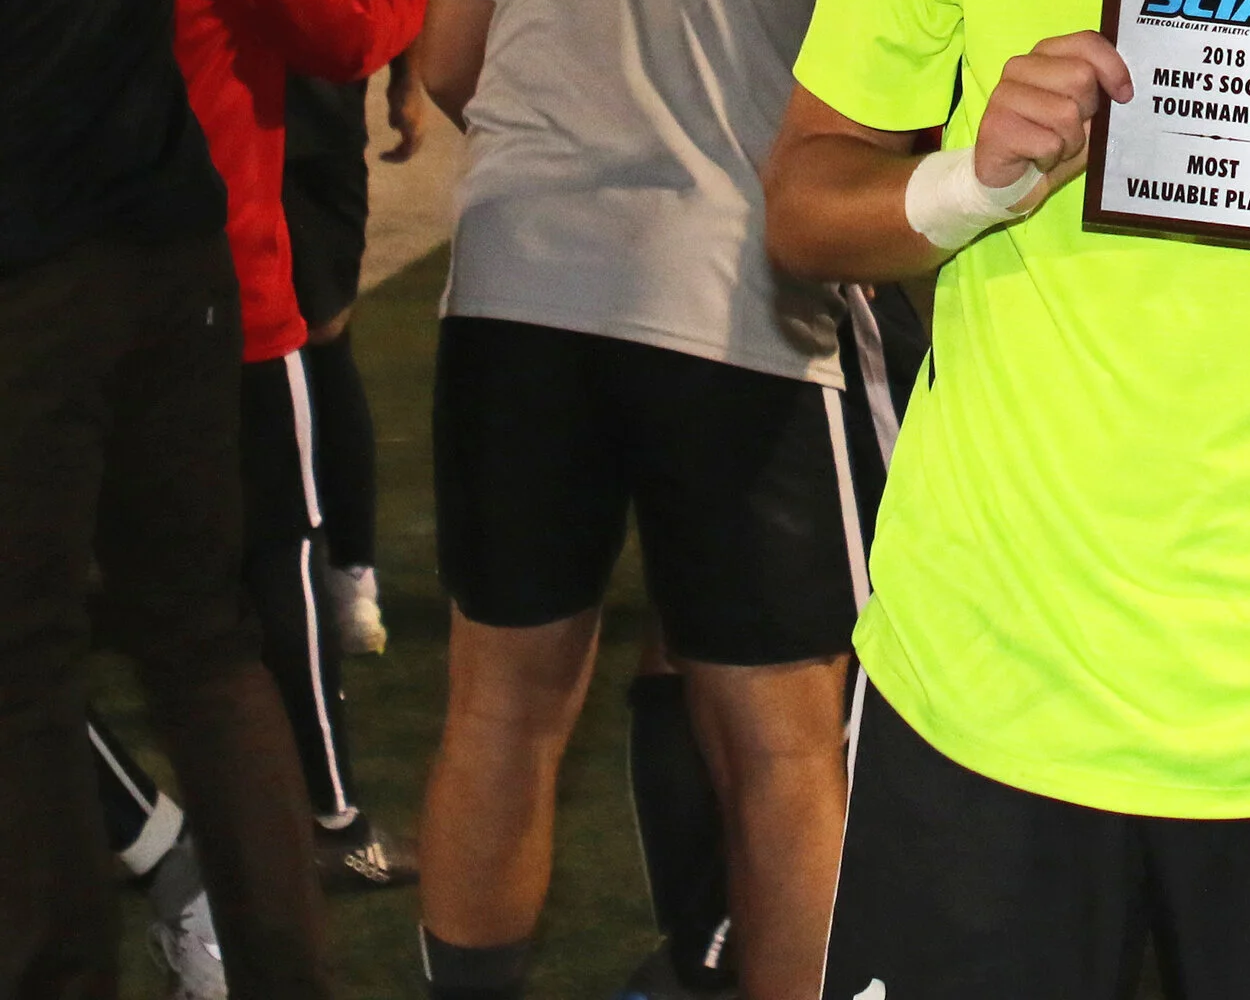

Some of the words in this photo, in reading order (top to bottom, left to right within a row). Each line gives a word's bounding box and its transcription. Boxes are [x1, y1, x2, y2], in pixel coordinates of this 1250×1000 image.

[1136, 16, 1209, 32] INTERCOLLEGIATE
[1211, 25, 1250, 37] ATHLETIC
[1202, 46, 1246, 68] 2018
[1152, 68, 1214, 91] MEN'S
[1187, 155, 1240, 179] MOST
[1127, 178, 1219, 207] VALUABLE
